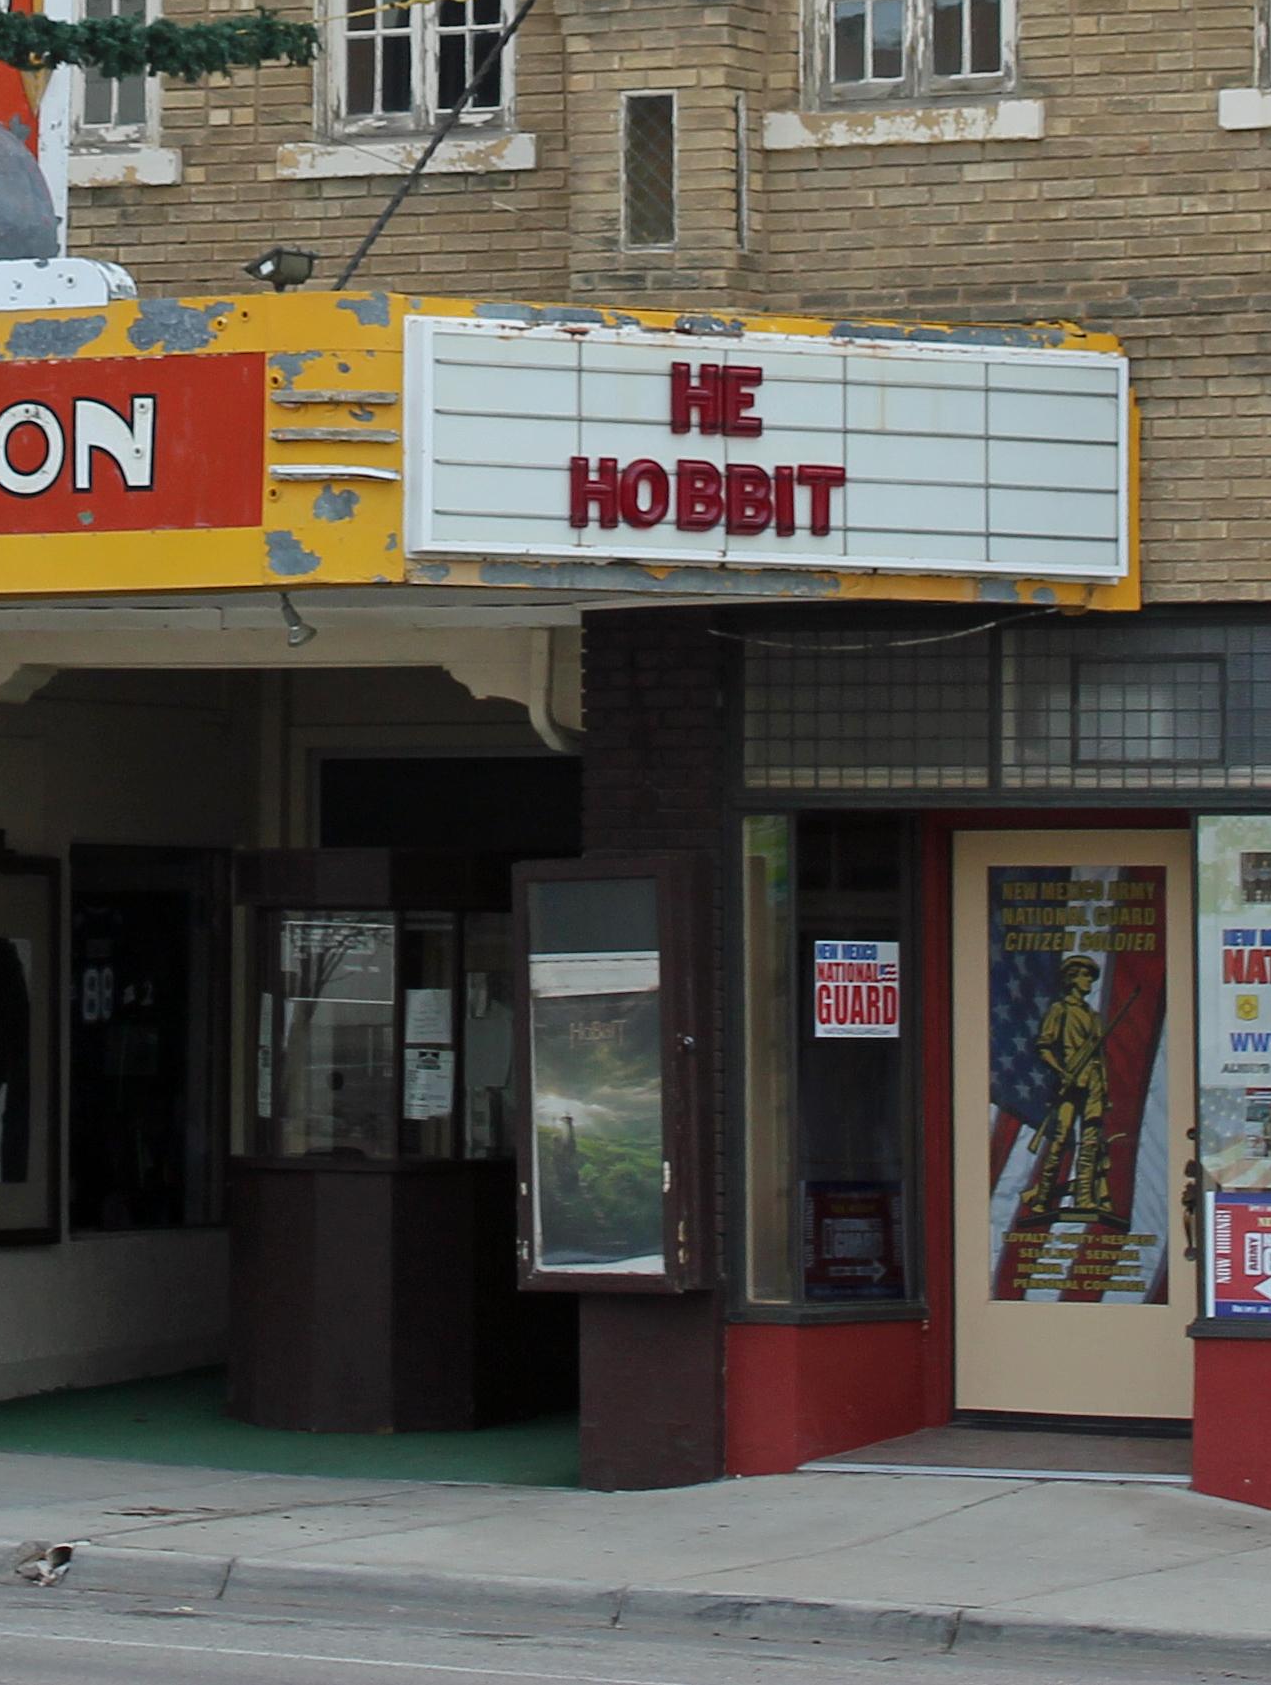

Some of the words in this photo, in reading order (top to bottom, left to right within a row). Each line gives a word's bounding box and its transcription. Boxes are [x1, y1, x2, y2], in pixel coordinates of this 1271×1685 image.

[671, 361, 763, 437] HE
[570, 455, 847, 537] HOBBIT
[1002, 882, 1037, 899] NEW
[1108, 882, 1156, 900] ARMY
[1002, 907, 1088, 926] NATIONAL
[1092, 907, 1157, 926] GUARD
[1005, 932, 1076, 951] CITIZEN
[1079, 932, 1157, 952] SOLDIER
[1223, 929, 1258, 947] NEW
[816, 962, 878, 983] NATIONAL
[817, 984, 898, 1025] GUARD
[1216, 1257, 1232, 1284] NOW
